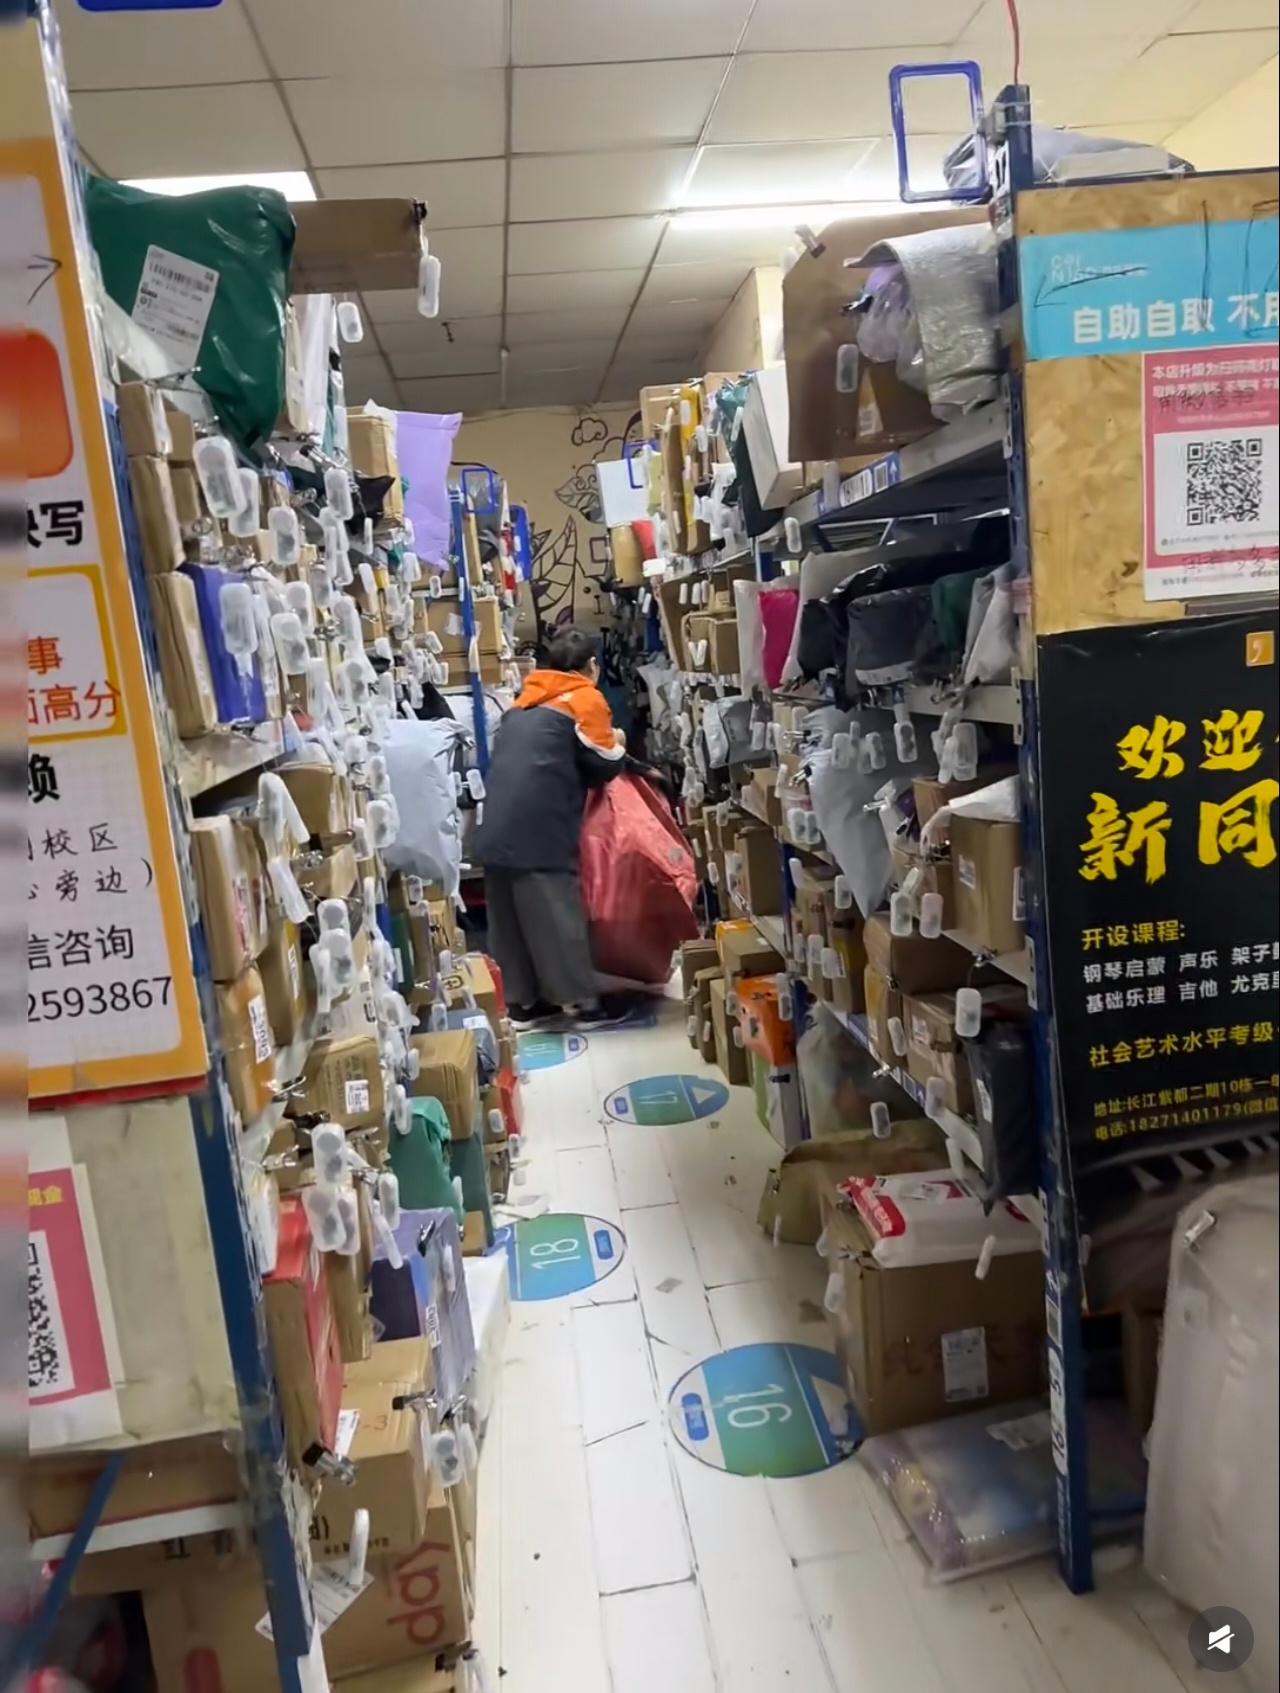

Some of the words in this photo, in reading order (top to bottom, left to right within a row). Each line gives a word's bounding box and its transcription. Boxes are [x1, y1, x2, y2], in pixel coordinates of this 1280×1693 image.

[1074, 298, 1215, 344] 自助自取
[28, 636, 63, 674] 事
[1116, 709, 1264, 779] 欢迎
[28, 822, 118, 861] 校区
[1078, 778, 1279, 886] 新同
[1081, 919, 1186, 950] 开设课程:
[1083, 956, 1166, 984] 钢琴启蒙
[1179, 950, 1218, 973] 声乐
[1086, 986, 1166, 1014] 基础乐理
[1178, 979, 1218, 1001] 吉他
[530, 1237, 581, 1270] 18
[723, 1382, 792, 1429] 16
